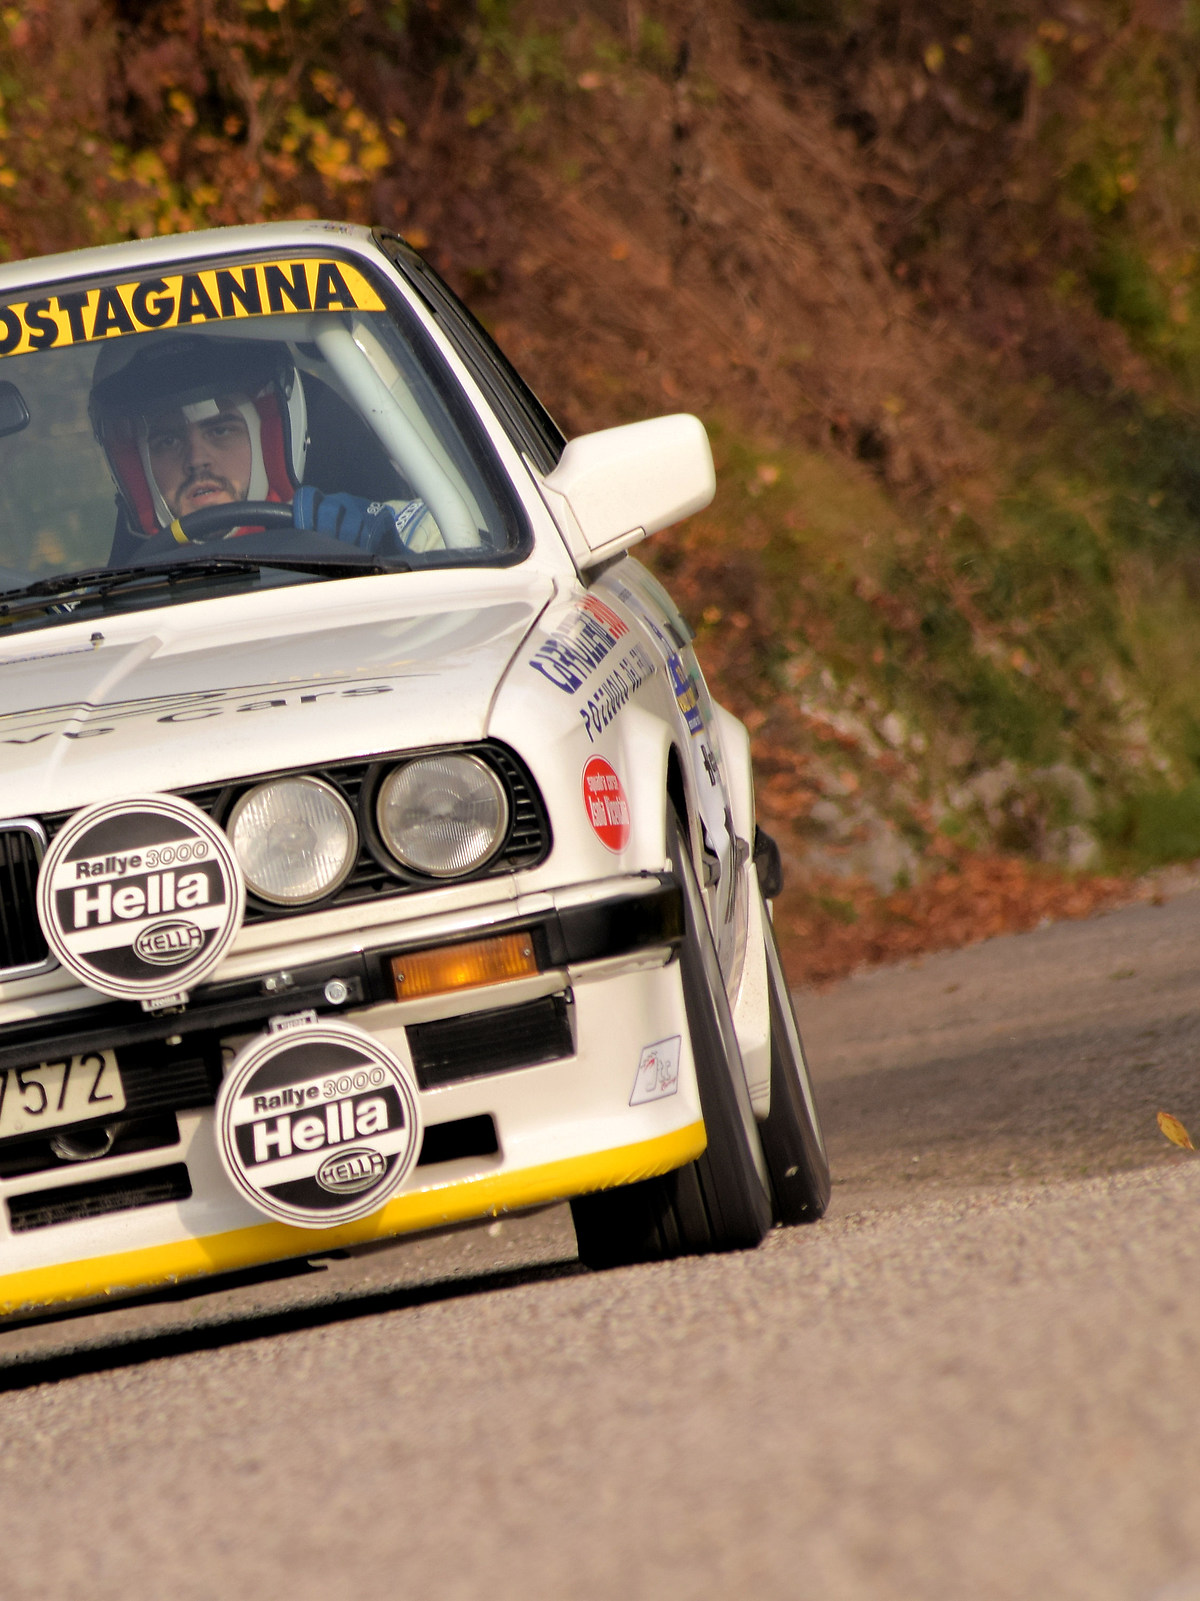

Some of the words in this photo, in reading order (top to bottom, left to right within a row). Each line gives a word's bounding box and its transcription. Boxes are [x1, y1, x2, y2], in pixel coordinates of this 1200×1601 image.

[157, 685, 394, 722] Cars
[75, 854, 142, 880] Rallye
[145, 841, 209, 868] 3000
[74, 872, 209, 928] Hella
[139, 926, 202, 954] HELLA
[253, 1084, 319, 1115] Rallye
[323, 1067, 385, 1098] 3000
[253, 1096, 388, 1162] Hella
[321, 1152, 385, 1184] HELLA
